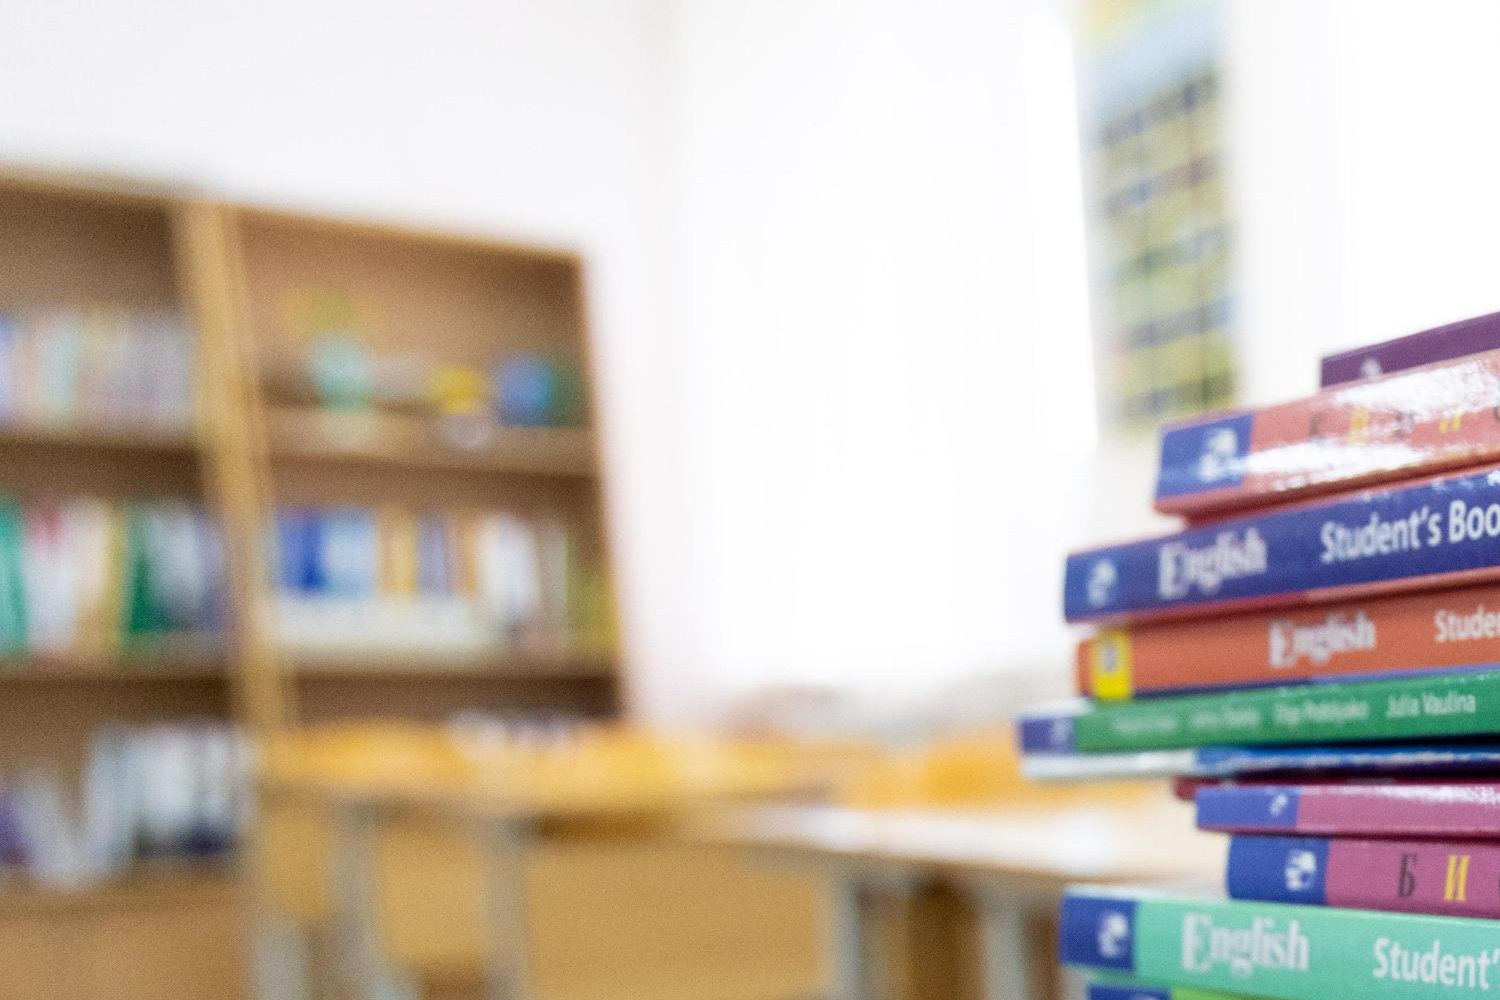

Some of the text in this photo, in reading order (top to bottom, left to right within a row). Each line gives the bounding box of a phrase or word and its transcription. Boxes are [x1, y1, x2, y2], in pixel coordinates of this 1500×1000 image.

[1159, 527, 1268, 599] English
[1321, 505, 1442, 564] Student's
[1269, 611, 1377, 668] English
[1180, 912, 1311, 977] English
